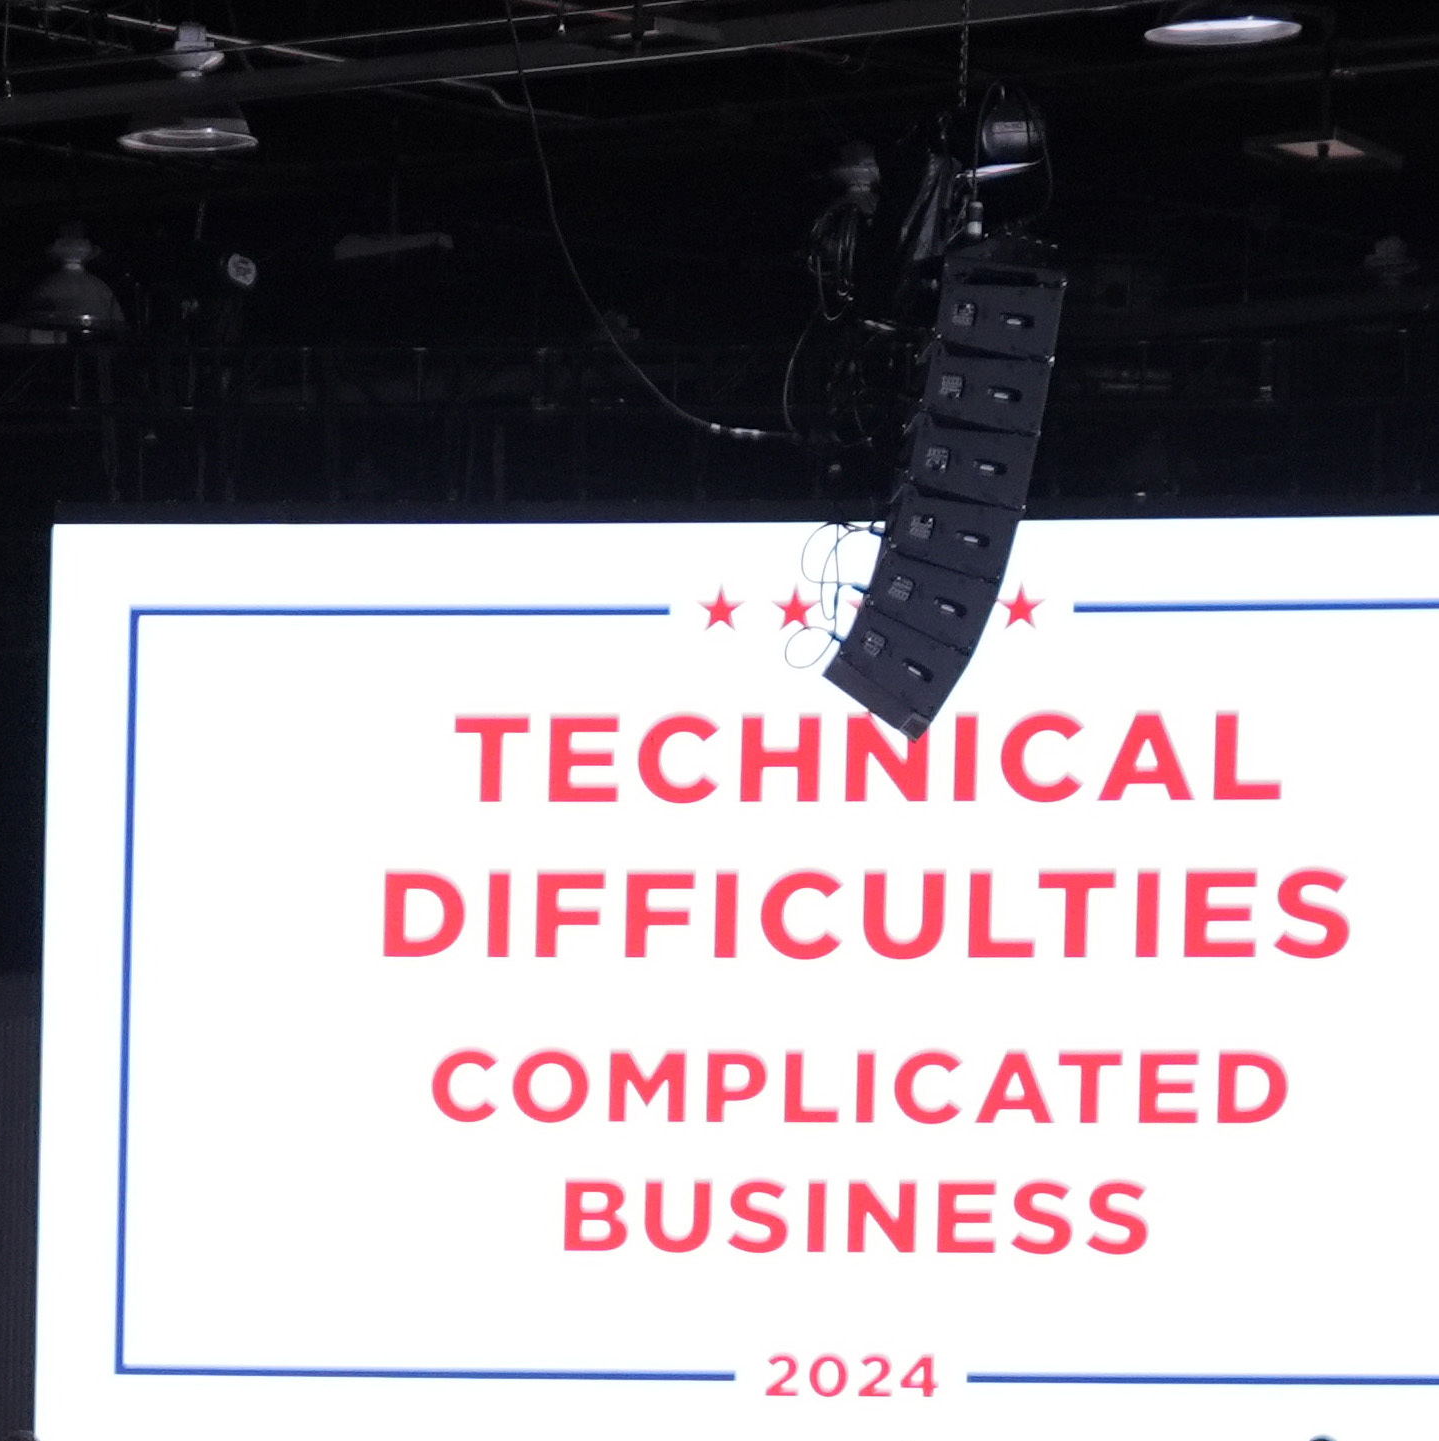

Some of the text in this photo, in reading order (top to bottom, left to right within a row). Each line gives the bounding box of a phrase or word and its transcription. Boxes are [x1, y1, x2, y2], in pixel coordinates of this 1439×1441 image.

[453, 709, 1282, 803] TECHNICAL
[382, 867, 1352, 960] DIFFICULTIES
[430, 1048, 1289, 1125] COMPLICATED
[562, 1180, 1150, 1254] BUSINESS
[764, 1354, 939, 1398] 2024
